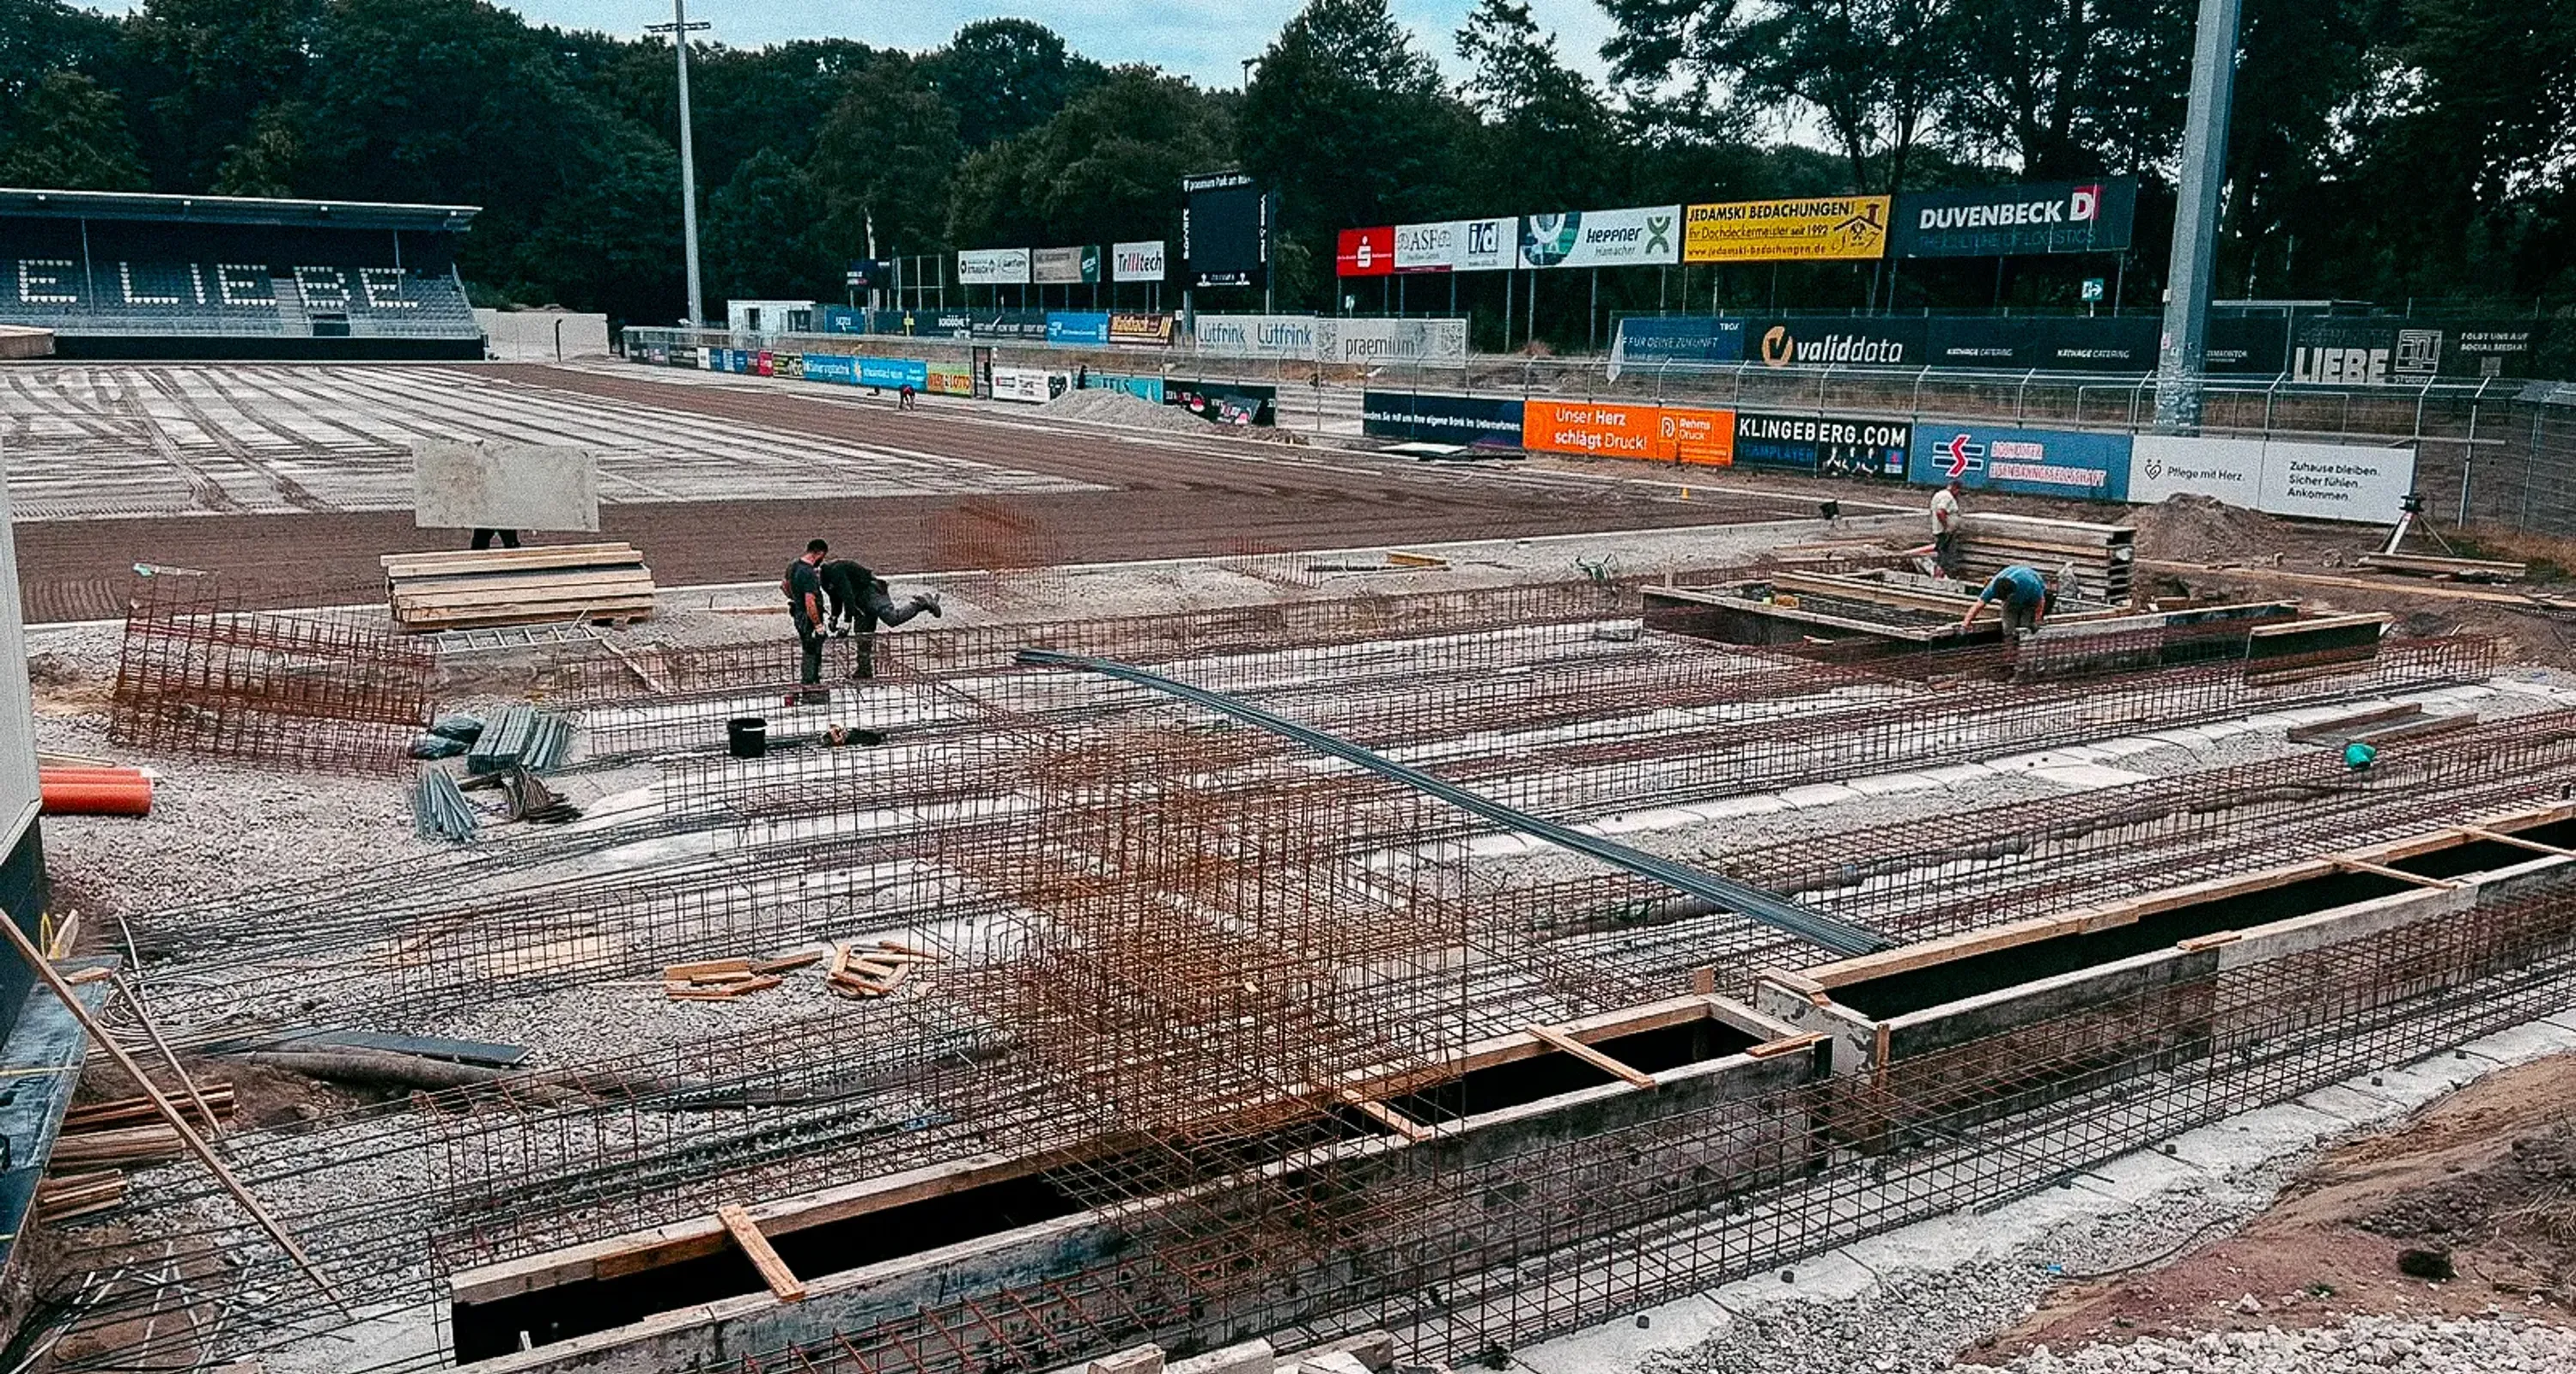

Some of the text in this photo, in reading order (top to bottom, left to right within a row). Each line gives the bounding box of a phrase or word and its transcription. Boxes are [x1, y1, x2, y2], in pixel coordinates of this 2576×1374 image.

[1688, 206, 1746, 222] JEDAMSKI
[1919, 200, 2065, 229] DUVENBECK
[1409, 226, 1439, 251] ASF
[1807, 223, 1829, 236] 1992
[118, 260, 419, 309] LIEBE
[1197, 322, 1246, 344] Lütfrink
[1256, 322, 1312, 345] Lütfrink
[1345, 336, 1418, 361] praemium
[1797, 333, 1904, 363] validdata
[2293, 346, 2390, 384] LIEBE
[1555, 408, 1627, 427] Unser Herz
[1554, 429, 1648, 451] schlägt Druck!
[1678, 429, 1705, 441] Druck
[1739, 417, 1907, 448] KLINGEBERG.COM
[2167, 465, 2199, 480] Pflege
[2200, 468, 2216, 479] mit
[2289, 460, 2335, 473] Zuhause
[2289, 473, 2323, 486] Sicher
